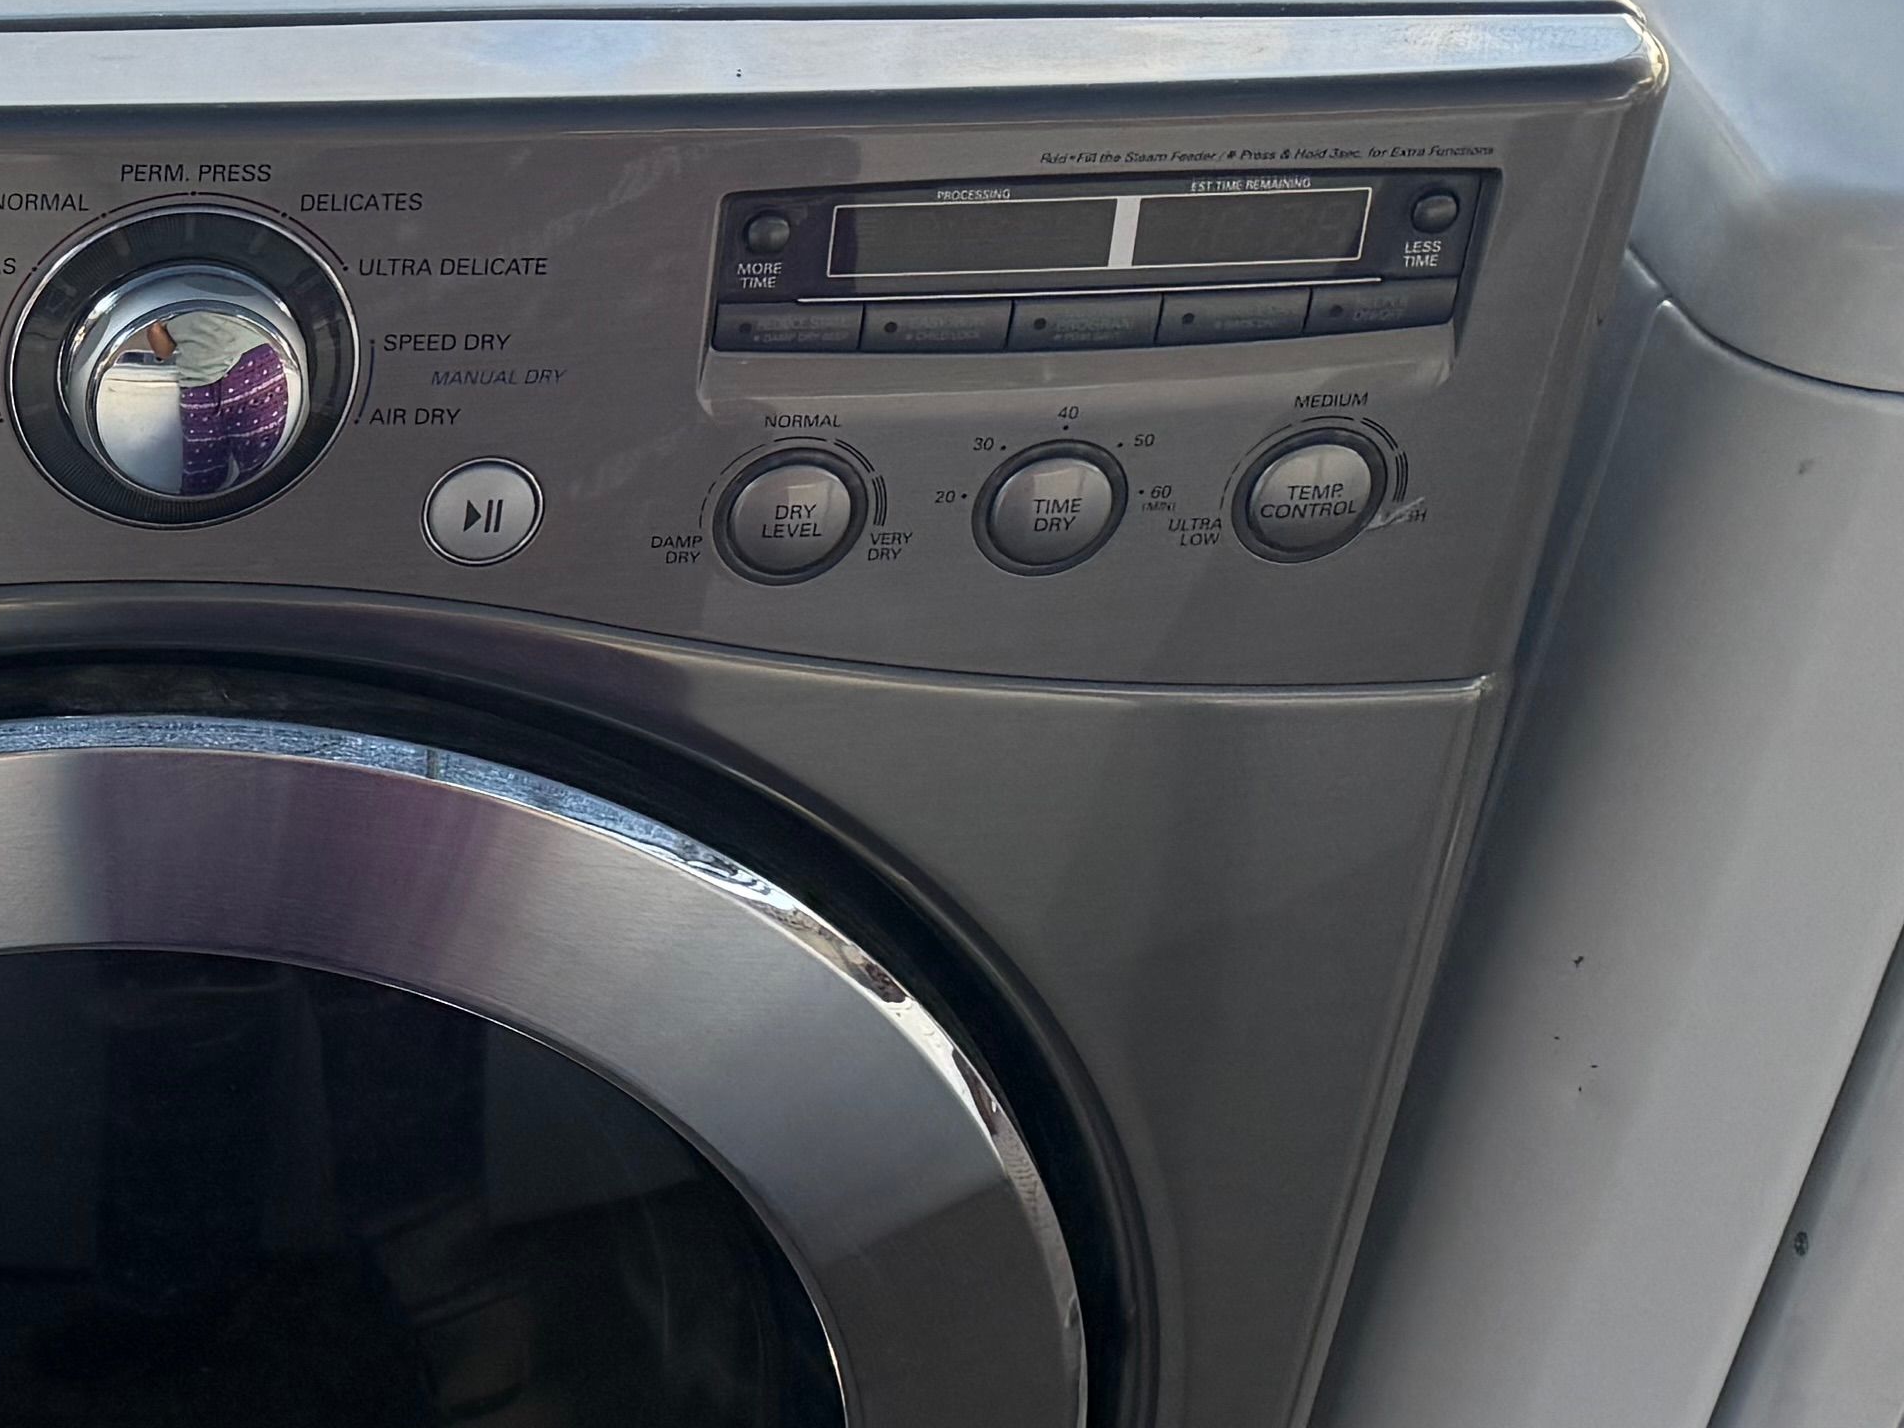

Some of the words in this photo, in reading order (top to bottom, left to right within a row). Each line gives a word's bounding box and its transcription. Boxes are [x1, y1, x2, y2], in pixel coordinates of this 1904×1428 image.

[119, 163, 189, 183] PERM.
[198, 162, 272, 183] PRESS
[1245, 176, 1312, 190] REMAINING
[299, 191, 424, 212] DELICATES
[935, 188, 1011, 200] PROCESSING
[1404, 241, 1442, 254] LESS
[357, 256, 433, 277] ULTRA
[436, 255, 549, 278] DELICATE
[1402, 254, 1440, 268] TIME
[736, 262, 783, 276] MORE
[741, 276, 777, 289] TIME
[382, 332, 455, 352] SPEED
[460, 332, 511, 352] DRY
[430, 369, 519, 387] MANUAL
[523, 367, 566, 387] DRY
[1293, 392, 1369, 410] MEDIUM
[368, 407, 408, 427] AIR
[413, 408, 461, 427] DRY
[1058, 405, 1080, 421] 40
[764, 414, 842, 429] NORMAL
[972, 437, 994, 452] 30
[1133, 433, 1156, 448] 50
[934, 490, 956, 504] 20
[1150, 485, 1172, 500] 60
[1288, 483, 1344, 501] TEMP.
[774, 503, 817, 519] DRY
[1033, 498, 1083, 515] TIME
[1259, 500, 1358, 519] CONTROL
[761, 523, 823, 539] LEVEL
[1033, 516, 1077, 532] DRY
[1168, 517, 1223, 532] ULTRA
[650, 535, 703, 550] DAMP
[869, 531, 913, 546] VERY
[1179, 532, 1221, 547] LOW
[665, 550, 701, 565] DRY
[866, 547, 902, 562] DRY
